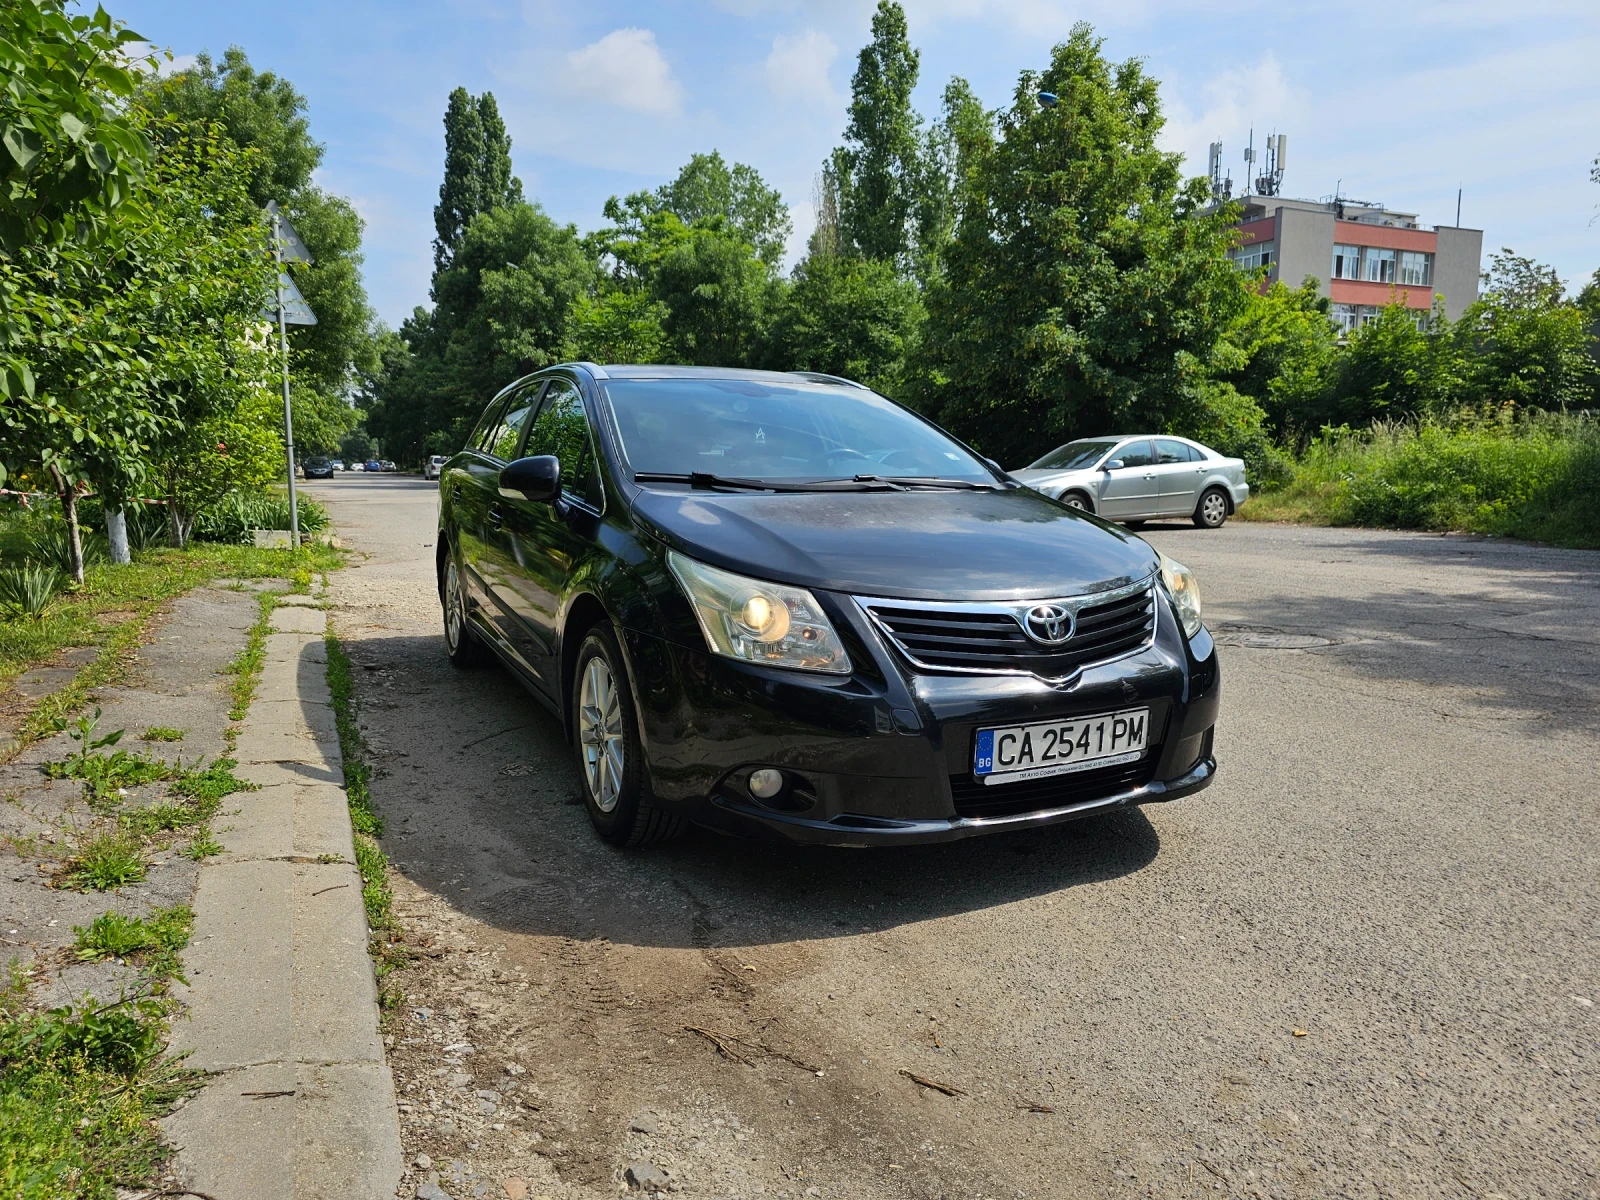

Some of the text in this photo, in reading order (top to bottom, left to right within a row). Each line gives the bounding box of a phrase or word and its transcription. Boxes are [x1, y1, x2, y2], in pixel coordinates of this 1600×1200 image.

[998, 715, 1144, 766] CA 2541 PM
[978, 757, 992, 768] BG
